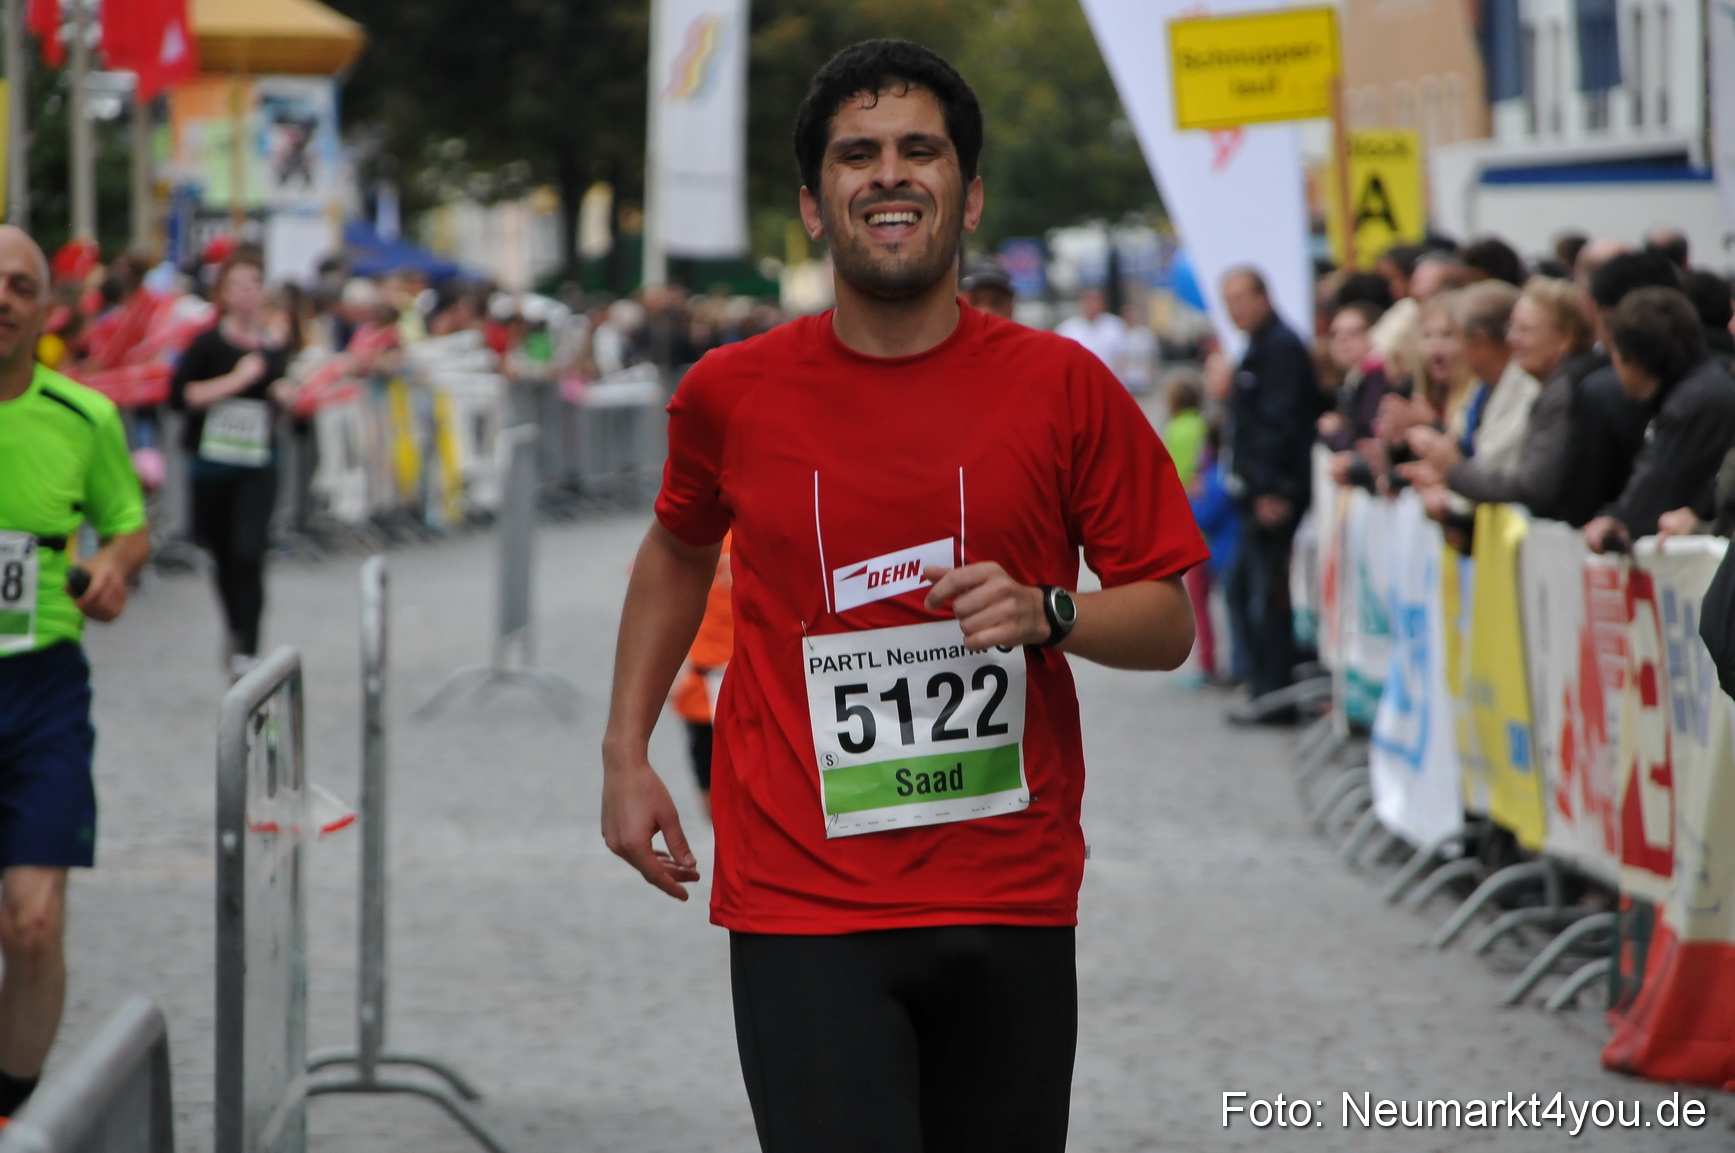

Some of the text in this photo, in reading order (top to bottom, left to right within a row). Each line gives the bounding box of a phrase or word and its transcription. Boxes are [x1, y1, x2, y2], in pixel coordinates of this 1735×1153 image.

[1352, 173, 1398, 232] A
[867, 559, 921, 590] DEHN
[809, 652, 882, 675] PARTL
[834, 664, 1009, 754] 5122
[825, 755, 834, 767] S
[895, 763, 964, 797] Saad
